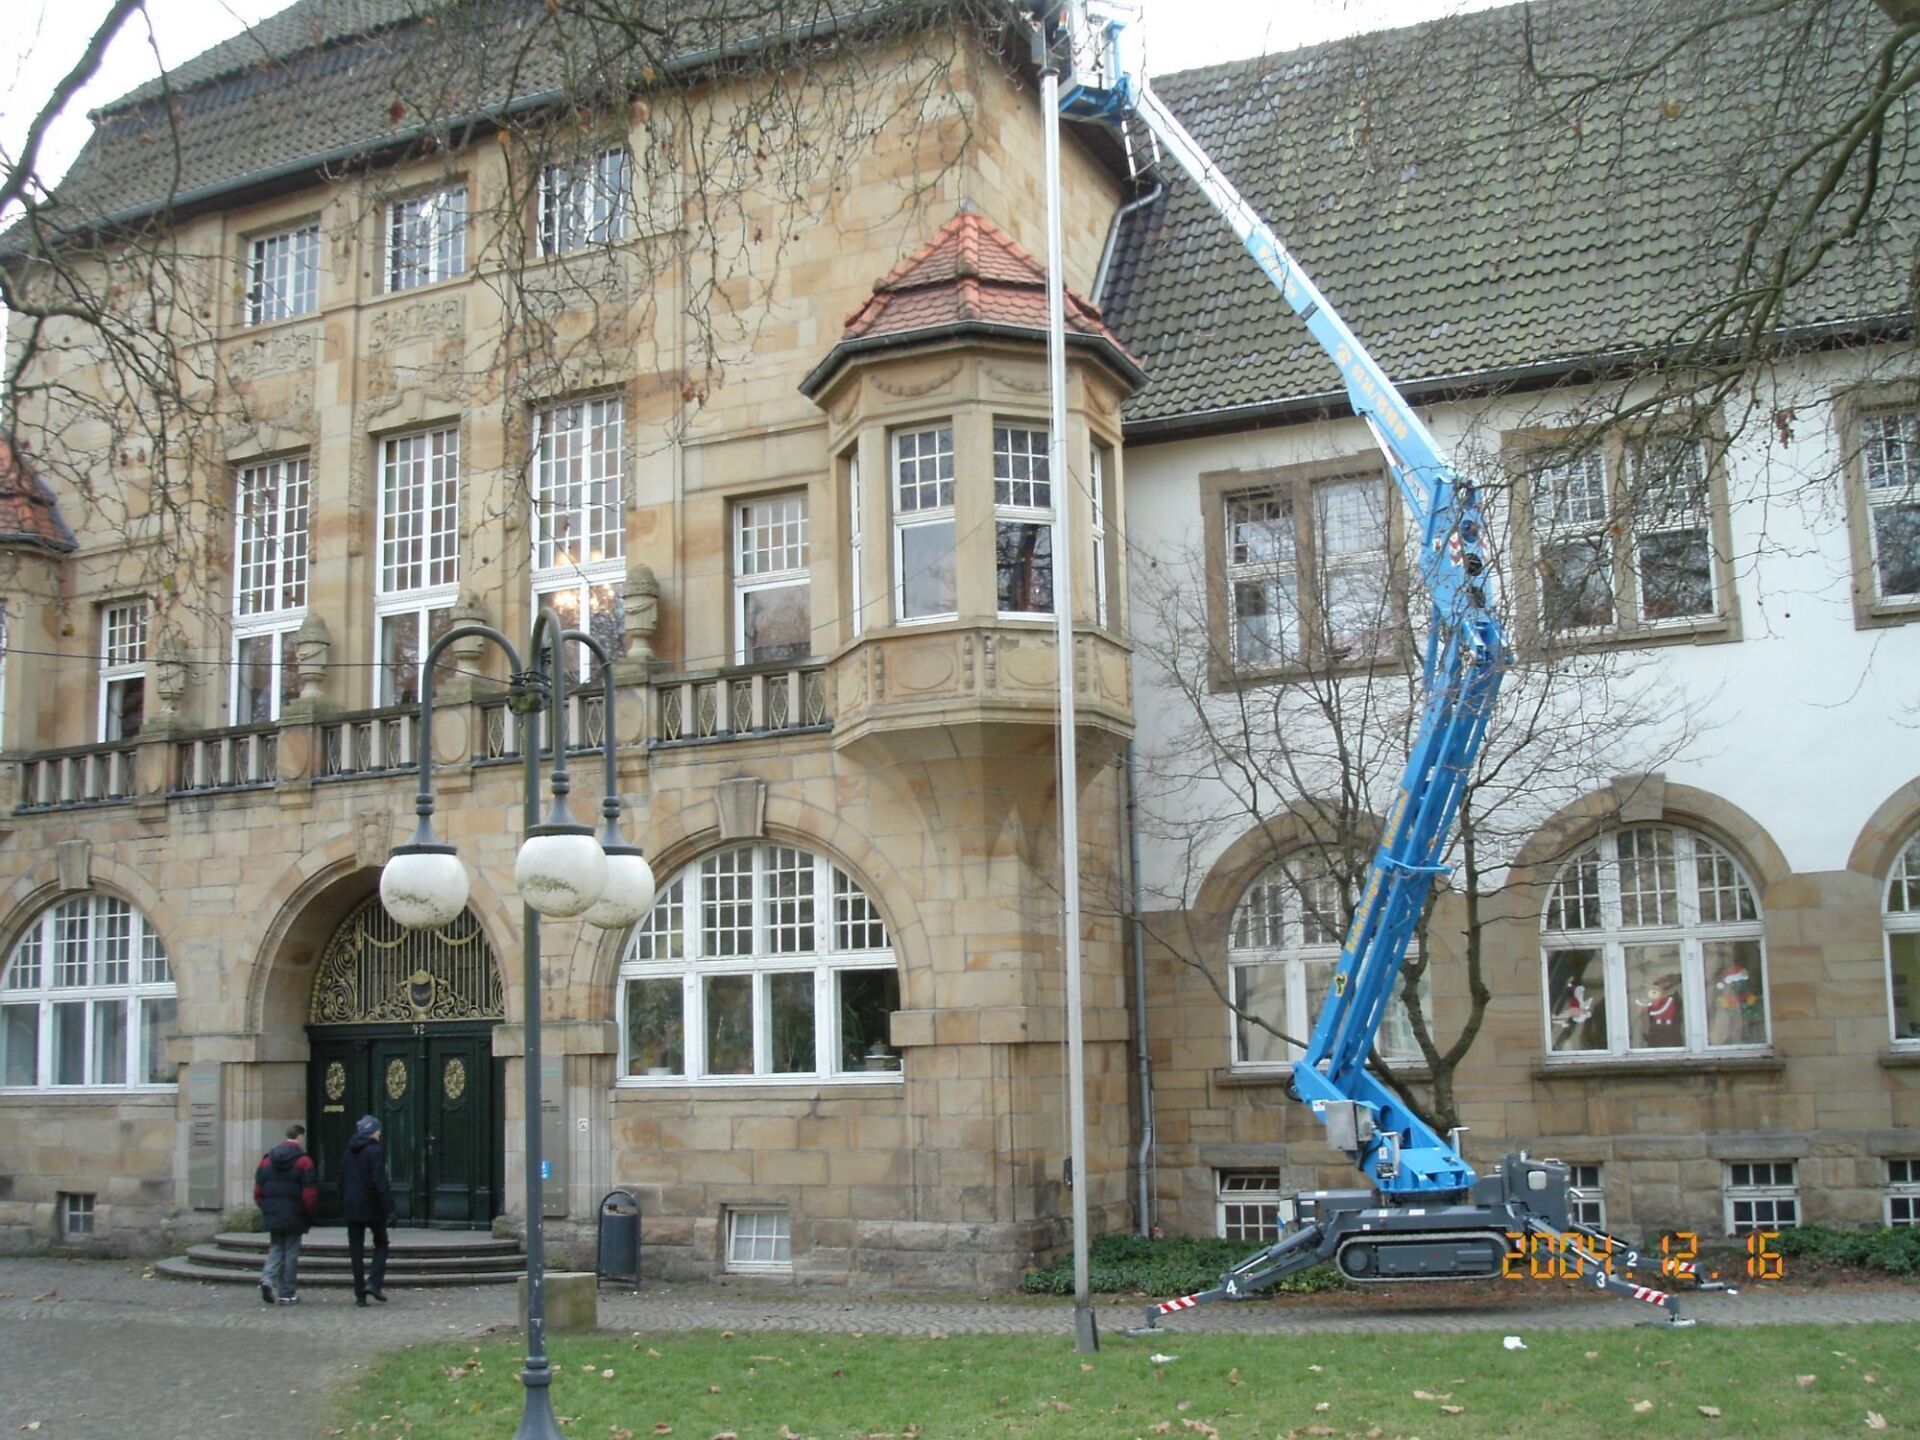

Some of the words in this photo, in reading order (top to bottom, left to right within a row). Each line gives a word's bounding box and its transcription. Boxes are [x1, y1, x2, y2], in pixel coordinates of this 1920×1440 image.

[1626, 1251, 1638, 1268] 2
[1226, 1279, 1238, 1295] 4
[1595, 1270, 1606, 1289] 3
